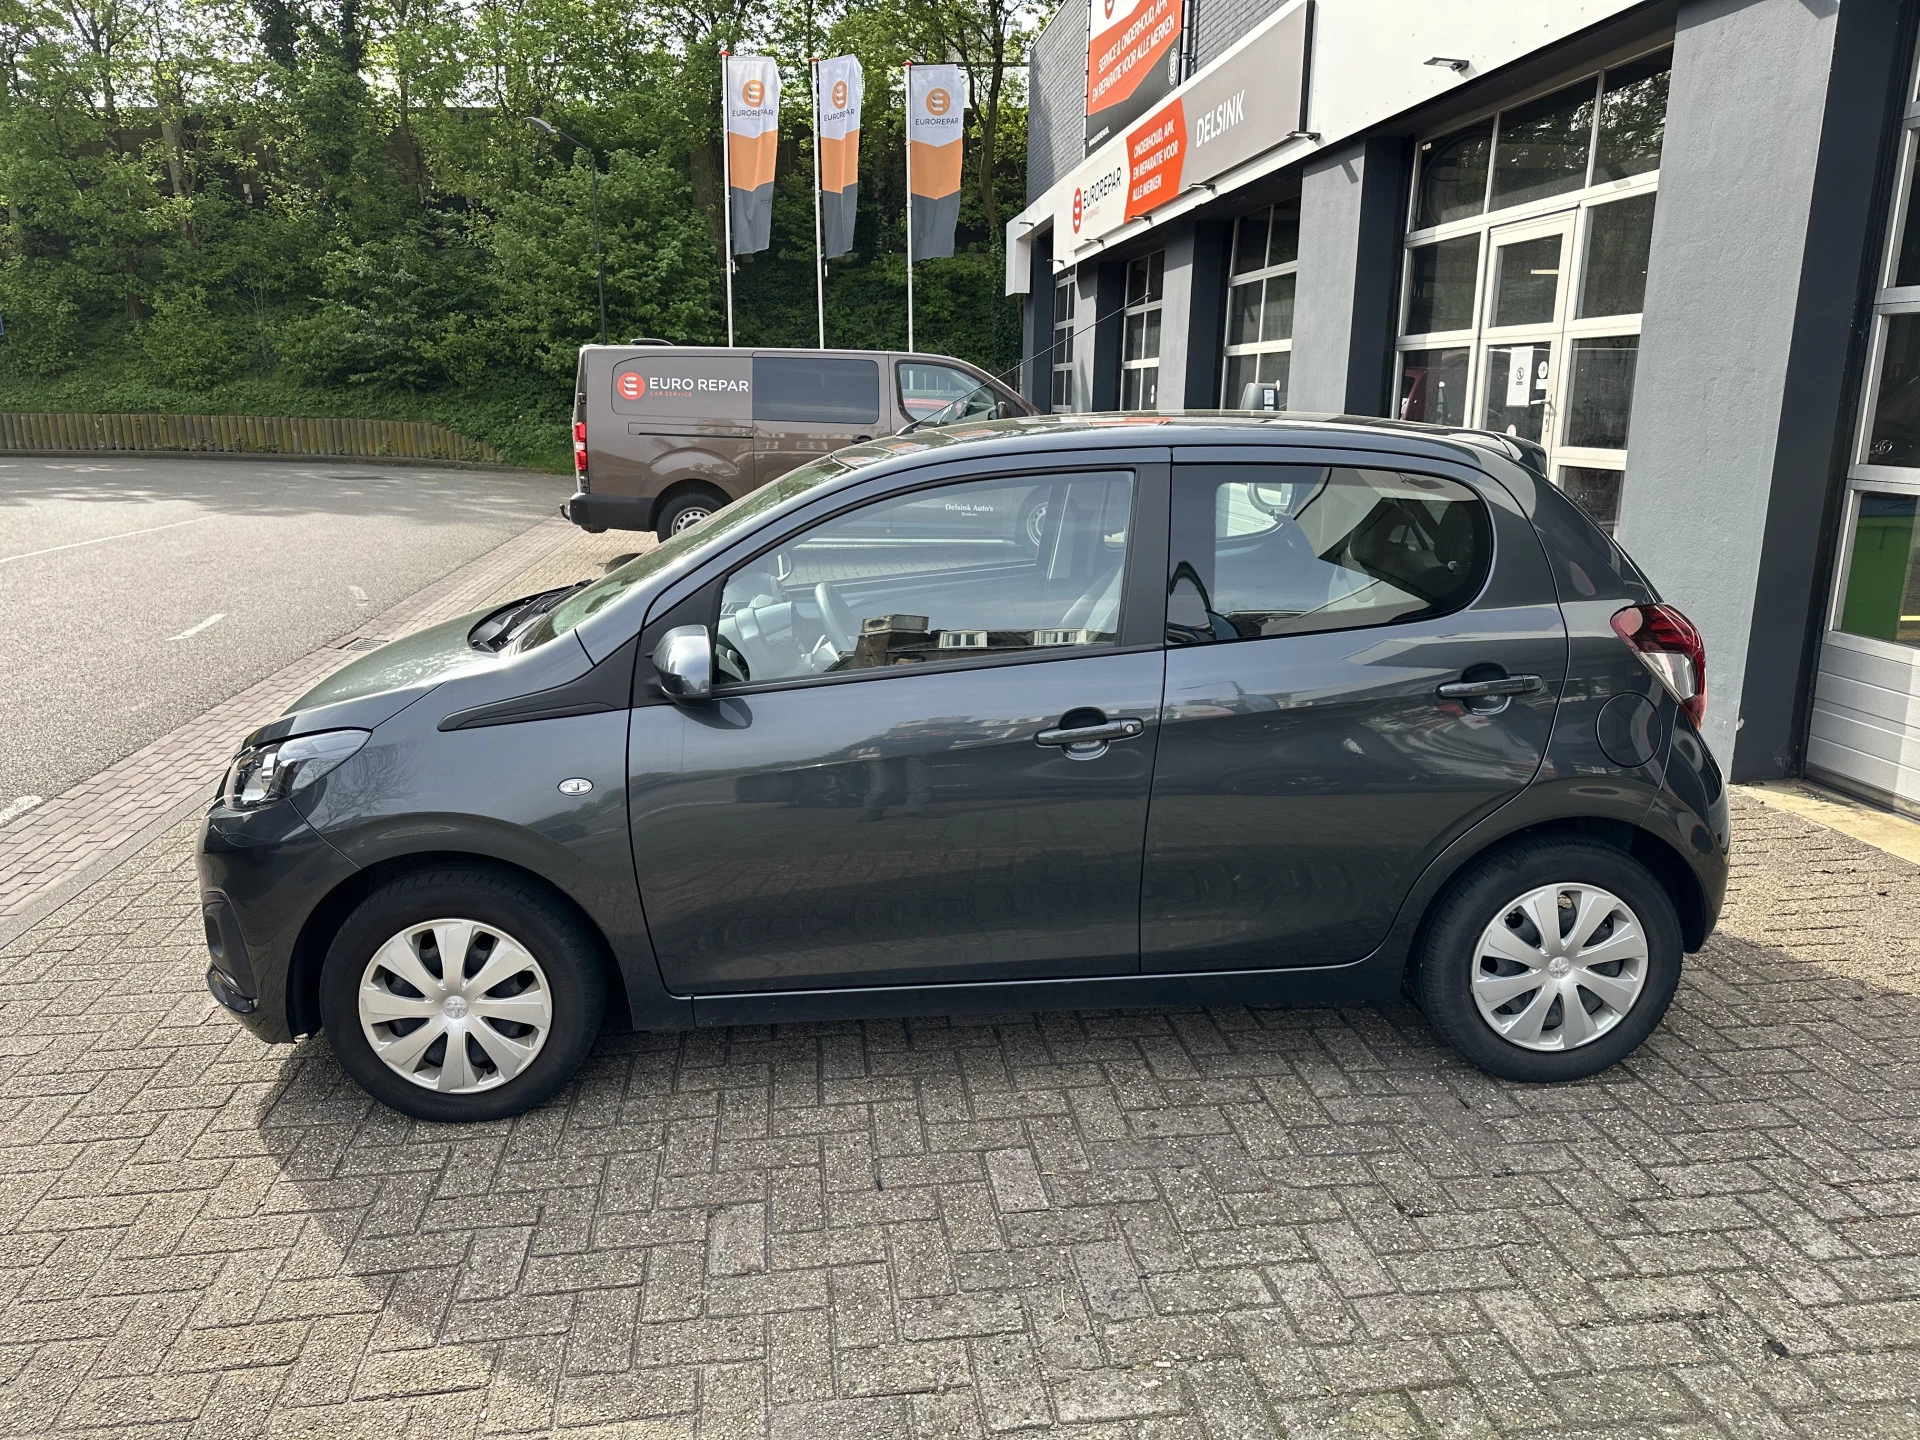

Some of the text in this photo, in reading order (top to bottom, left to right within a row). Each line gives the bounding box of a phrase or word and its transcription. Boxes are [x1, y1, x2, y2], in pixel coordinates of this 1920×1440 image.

[1136, 34, 1151, 61] ALLE
[1098, 43, 1117, 75] SERVICE
[915, 117, 959, 126] EUROREPAR
[1163, 118, 1175, 138] APK
[1196, 89, 1246, 148] DELSINK
[1163, 139, 1179, 161] VOOR
[1083, 166, 1122, 210] EUROREPAR
[649, 377, 749, 392] EURO REPAR
[945, 503, 971, 511] Delsink
